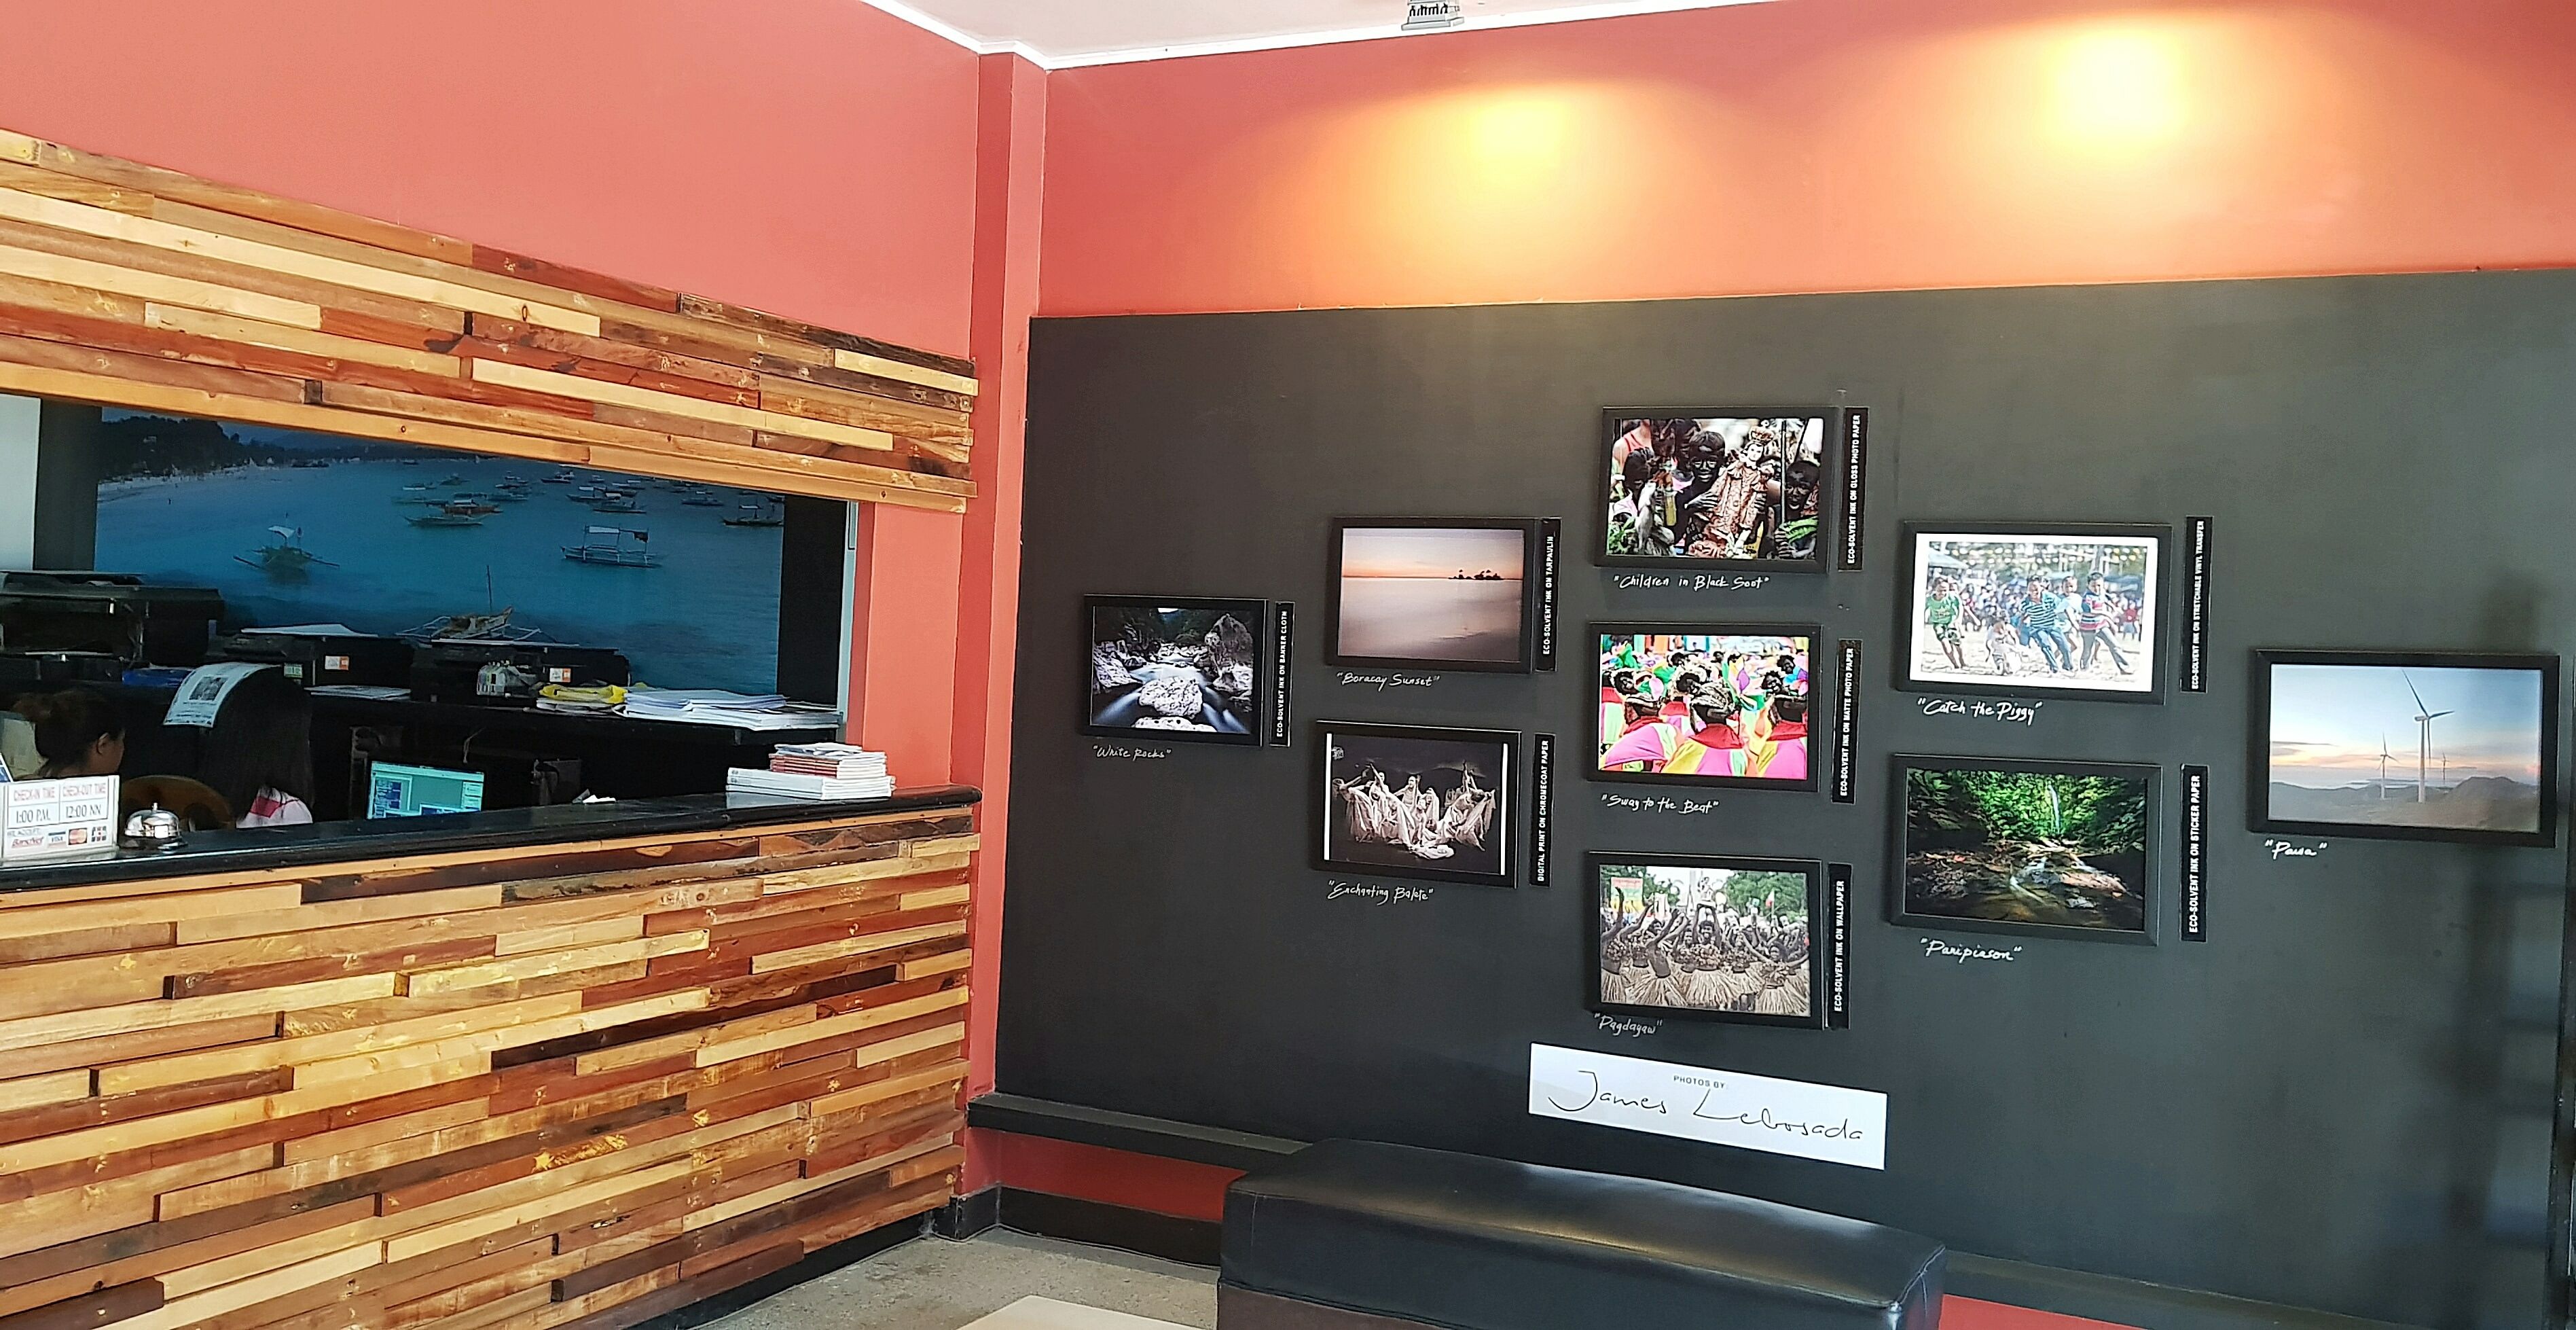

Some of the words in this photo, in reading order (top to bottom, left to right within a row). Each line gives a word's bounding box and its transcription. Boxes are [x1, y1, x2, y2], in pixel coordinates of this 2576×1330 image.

[1852, 415, 1860, 438] PAPER
[1850, 465, 1858, 488] GLOSS
[1850, 490, 1857, 501] ON
[1847, 516, 1856, 564] ECO-SOLVENT
[2196, 521, 2204, 554] TRANSFER
[1546, 537, 1554, 575] TARPAULIN
[2195, 555, 2203, 574] VINYL
[1546, 577, 1553, 588] ON
[1678, 576, 1690, 587] in
[1693, 575, 1730, 592] Black
[2193, 576, 2202, 620] STRETCHABLE
[1543, 605, 1552, 654] ECO-SOLVENT
[2193, 622, 2200, 631] ON
[1279, 665, 1286, 675] ON
[1845, 648, 1854, 671] PAPER
[2192, 645, 2200, 689] ECO-SOLVENT
[1844, 672, 1853, 697] PHOTO
[1843, 698, 1851, 721] MATTE
[1970, 701, 1995, 718] the
[1843, 722, 1851, 733] ON
[1541, 740, 1549, 764] PAPER
[1842, 734, 1850, 747] INK
[1840, 748, 1849, 796] ECO-SOLVENT
[1539, 766, 1548, 816] CHROMECOAT
[2191, 776, 2200, 804] PAPER
[16, 809, 34, 824] 1:00
[65, 804, 88, 819] 12:00
[1642, 797, 1655, 811] to
[1657, 797, 1677, 813] the
[1539, 817, 1546, 828] ON
[2190, 805, 2200, 842] STICKER
[2190, 843, 2199, 856] ON
[1537, 853, 1545, 882] DIGITAL
[2190, 858, 2199, 873] INK
[1836, 880, 1845, 927] WALLPAPER
[2189, 874, 2198, 933] ECO-SOLVENT
[1836, 929, 1844, 940] ON
[1835, 942, 1844, 956] INK
[1834, 957, 1843, 1011] ECO-SOLVENT
[1548, 1069, 1667, 1115] James
[1673, 1075, 1711, 1088] PHOTOS
